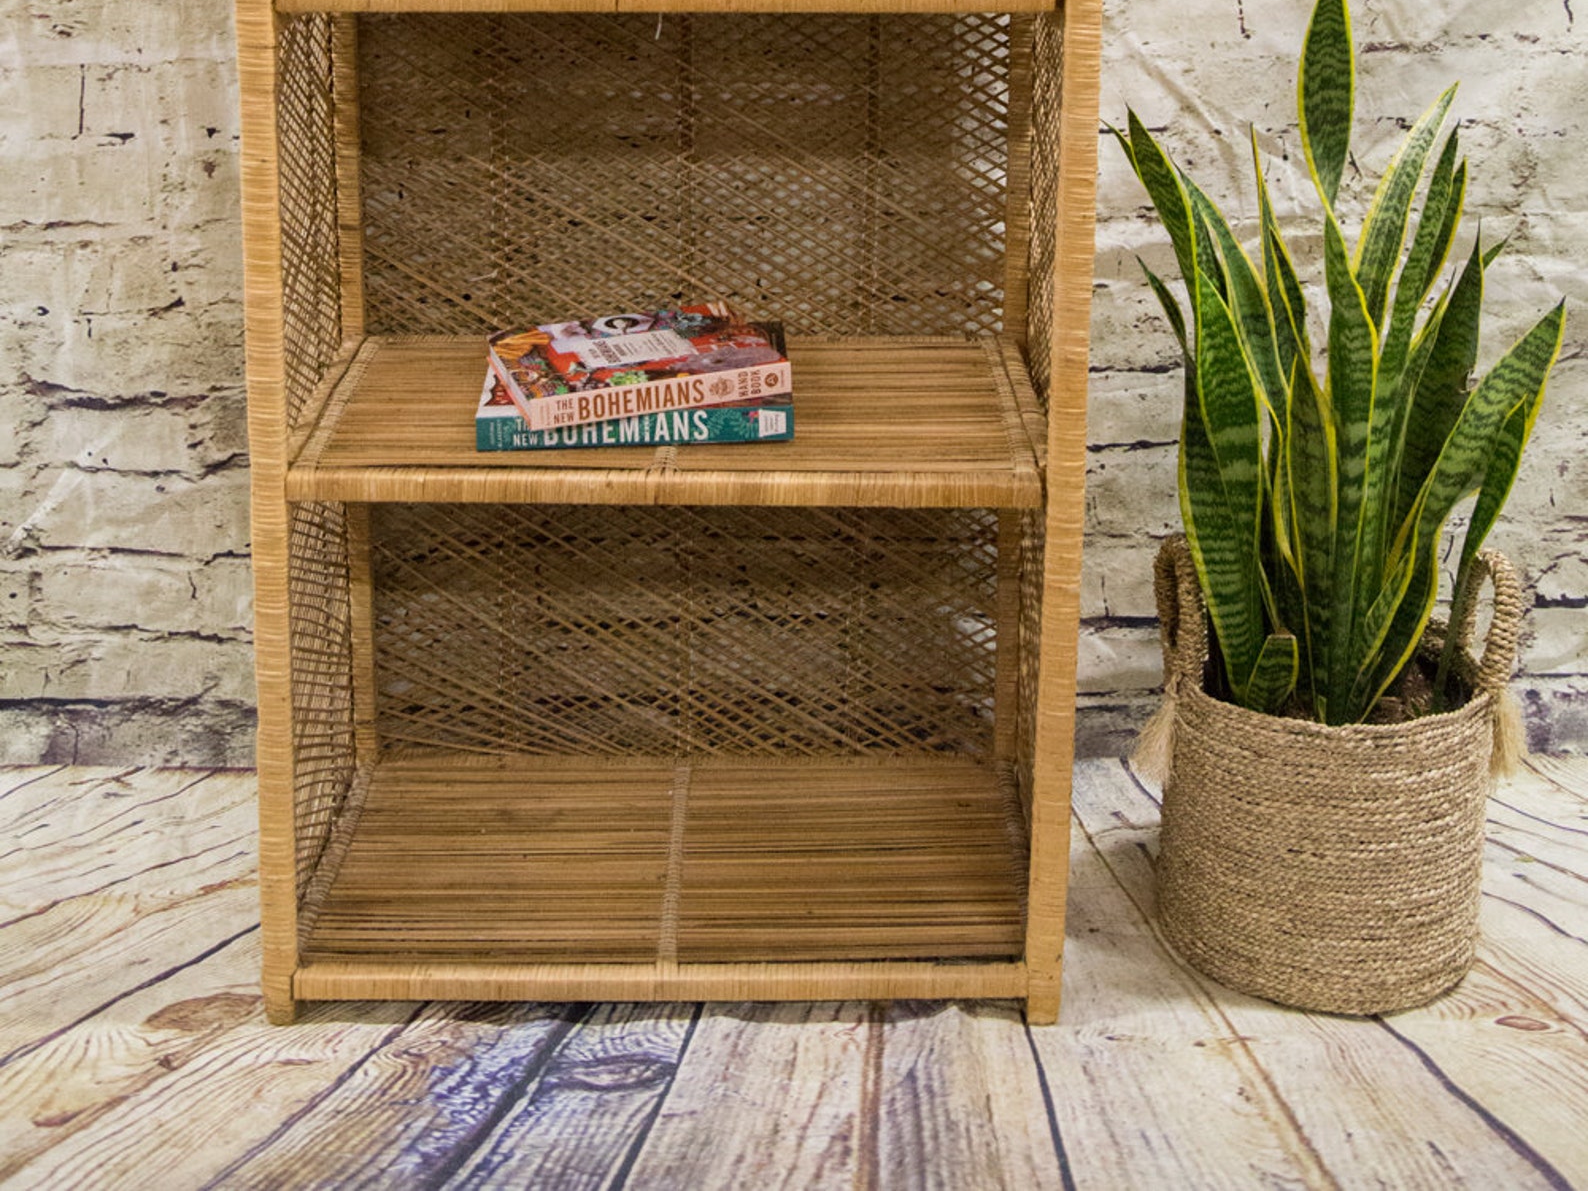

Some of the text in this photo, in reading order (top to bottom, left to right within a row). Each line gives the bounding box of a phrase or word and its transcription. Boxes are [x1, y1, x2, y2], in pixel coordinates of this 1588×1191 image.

[556, 398, 574, 411] THE
[578, 379, 705, 421] BOHEMIANS
[553, 412, 575, 425] NEW
[513, 433, 538, 447] NEW
